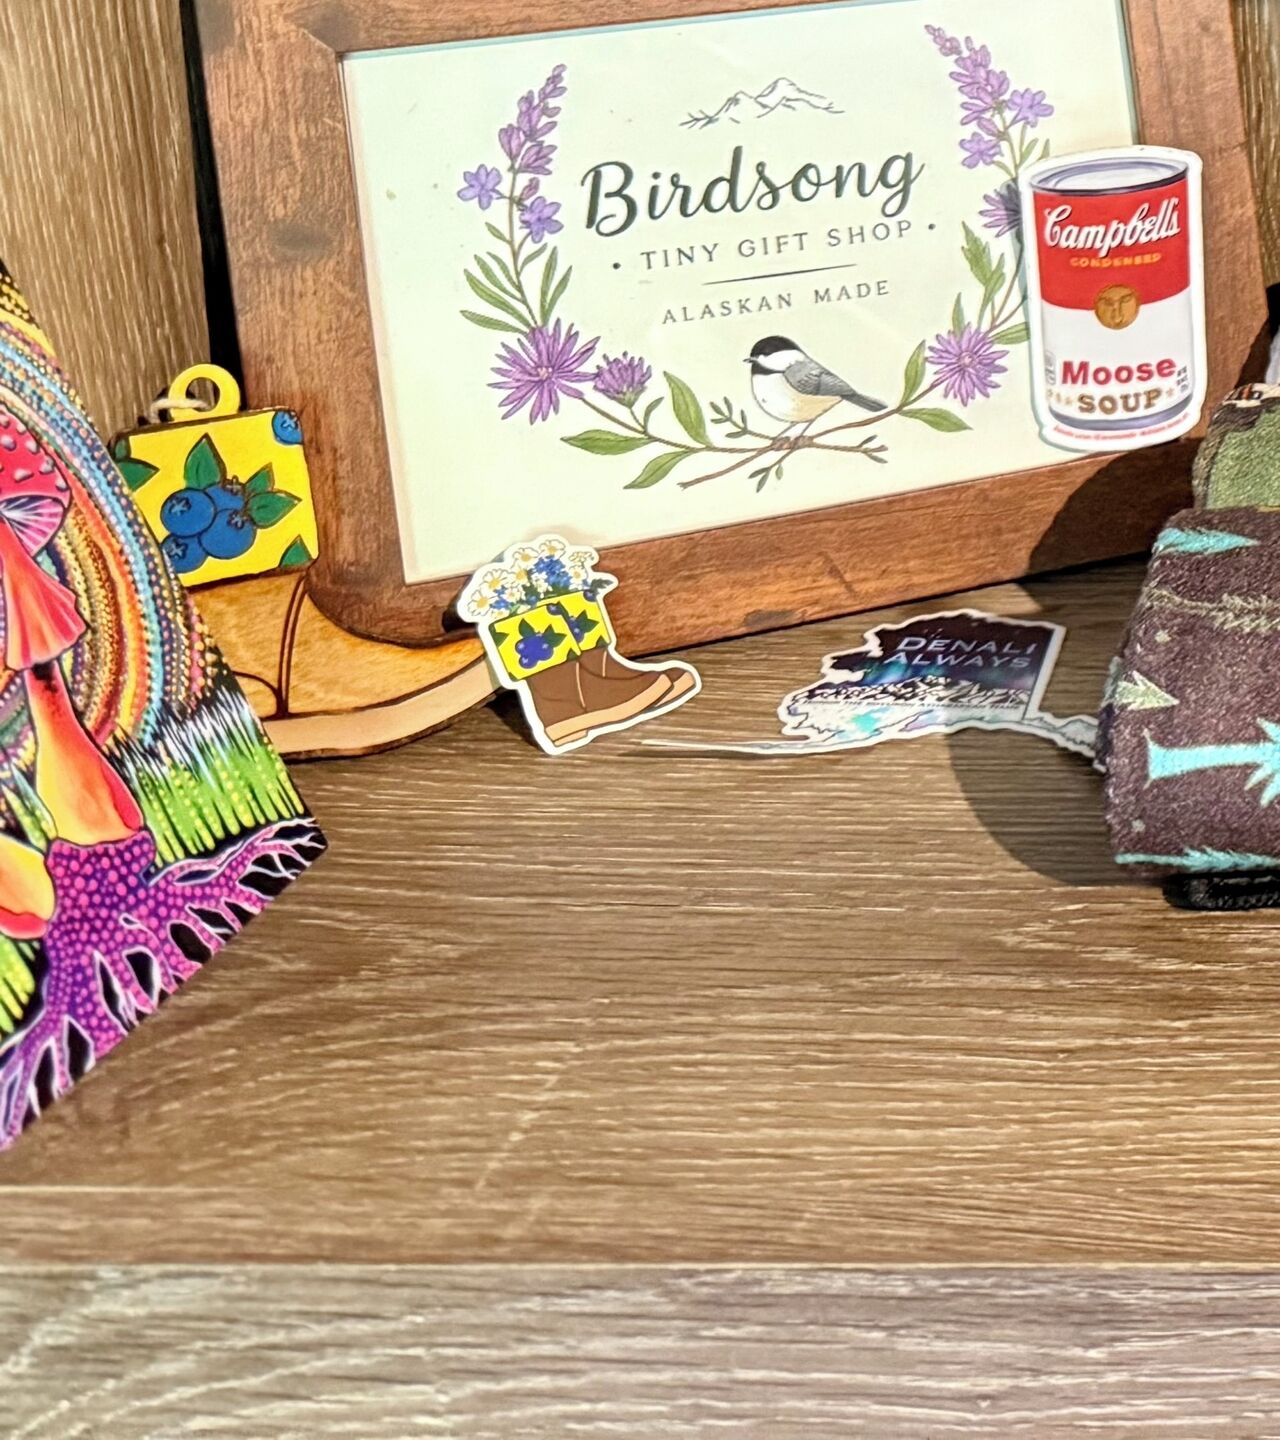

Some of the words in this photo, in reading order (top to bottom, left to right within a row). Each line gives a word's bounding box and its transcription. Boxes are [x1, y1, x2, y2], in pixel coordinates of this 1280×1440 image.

[580, 145, 926, 237] Birdsong
[640, 243, 719, 269] TINY
[738, 232, 809, 258] GIFT
[827, 220, 912, 247] SHOP
[1044, 197, 1182, 258] Campbell's
[662, 293, 793, 325] ALASKAN
[814, 280, 890, 304] MADE
[1061, 358, 1177, 386] Moose
[1077, 387, 1162, 415] SOUP
[883, 652, 1031, 668] ALWAYS
[896, 637, 1038, 655] DENALI
